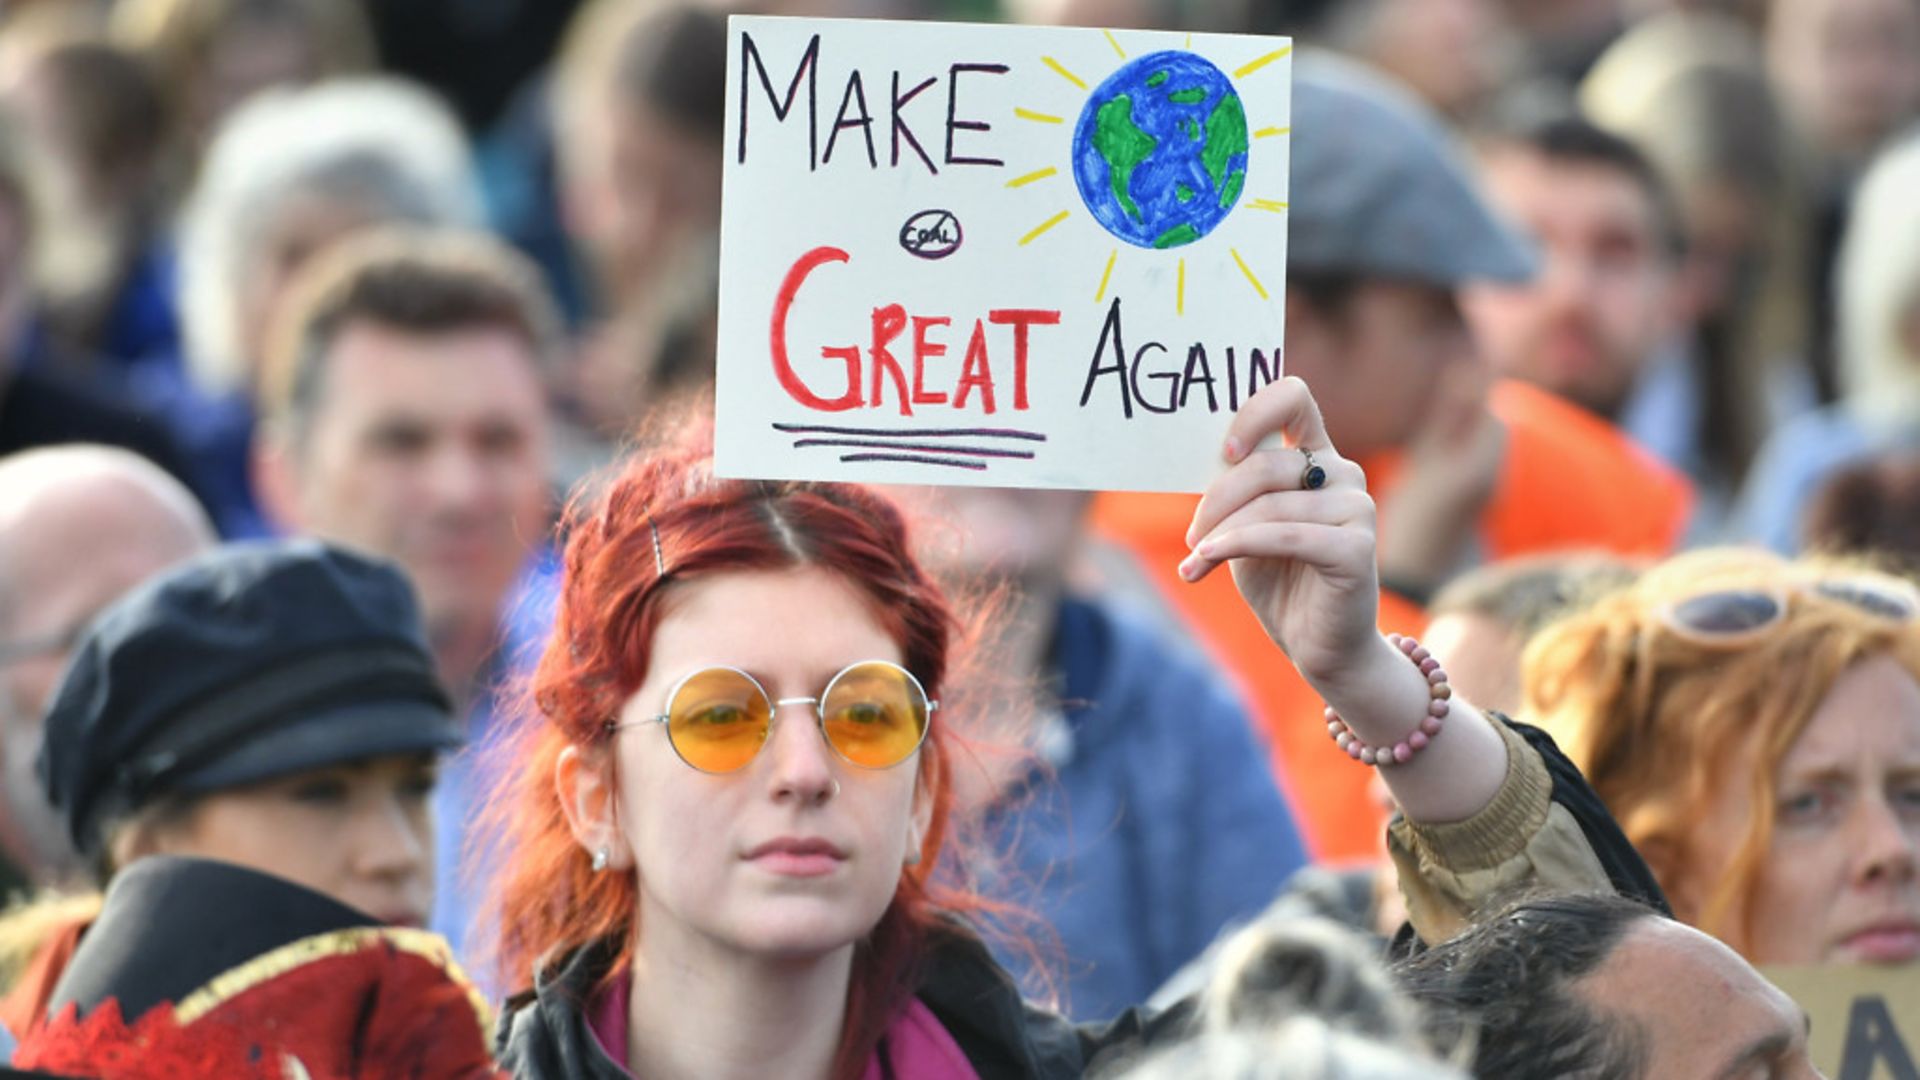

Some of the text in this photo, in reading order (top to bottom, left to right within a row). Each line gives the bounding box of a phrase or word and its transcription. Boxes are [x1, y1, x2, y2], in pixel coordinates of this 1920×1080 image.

[738, 31, 1010, 173] MAKE
[902, 226, 956, 245] COAL
[770, 246, 1281, 418] GREAT AGAIN
